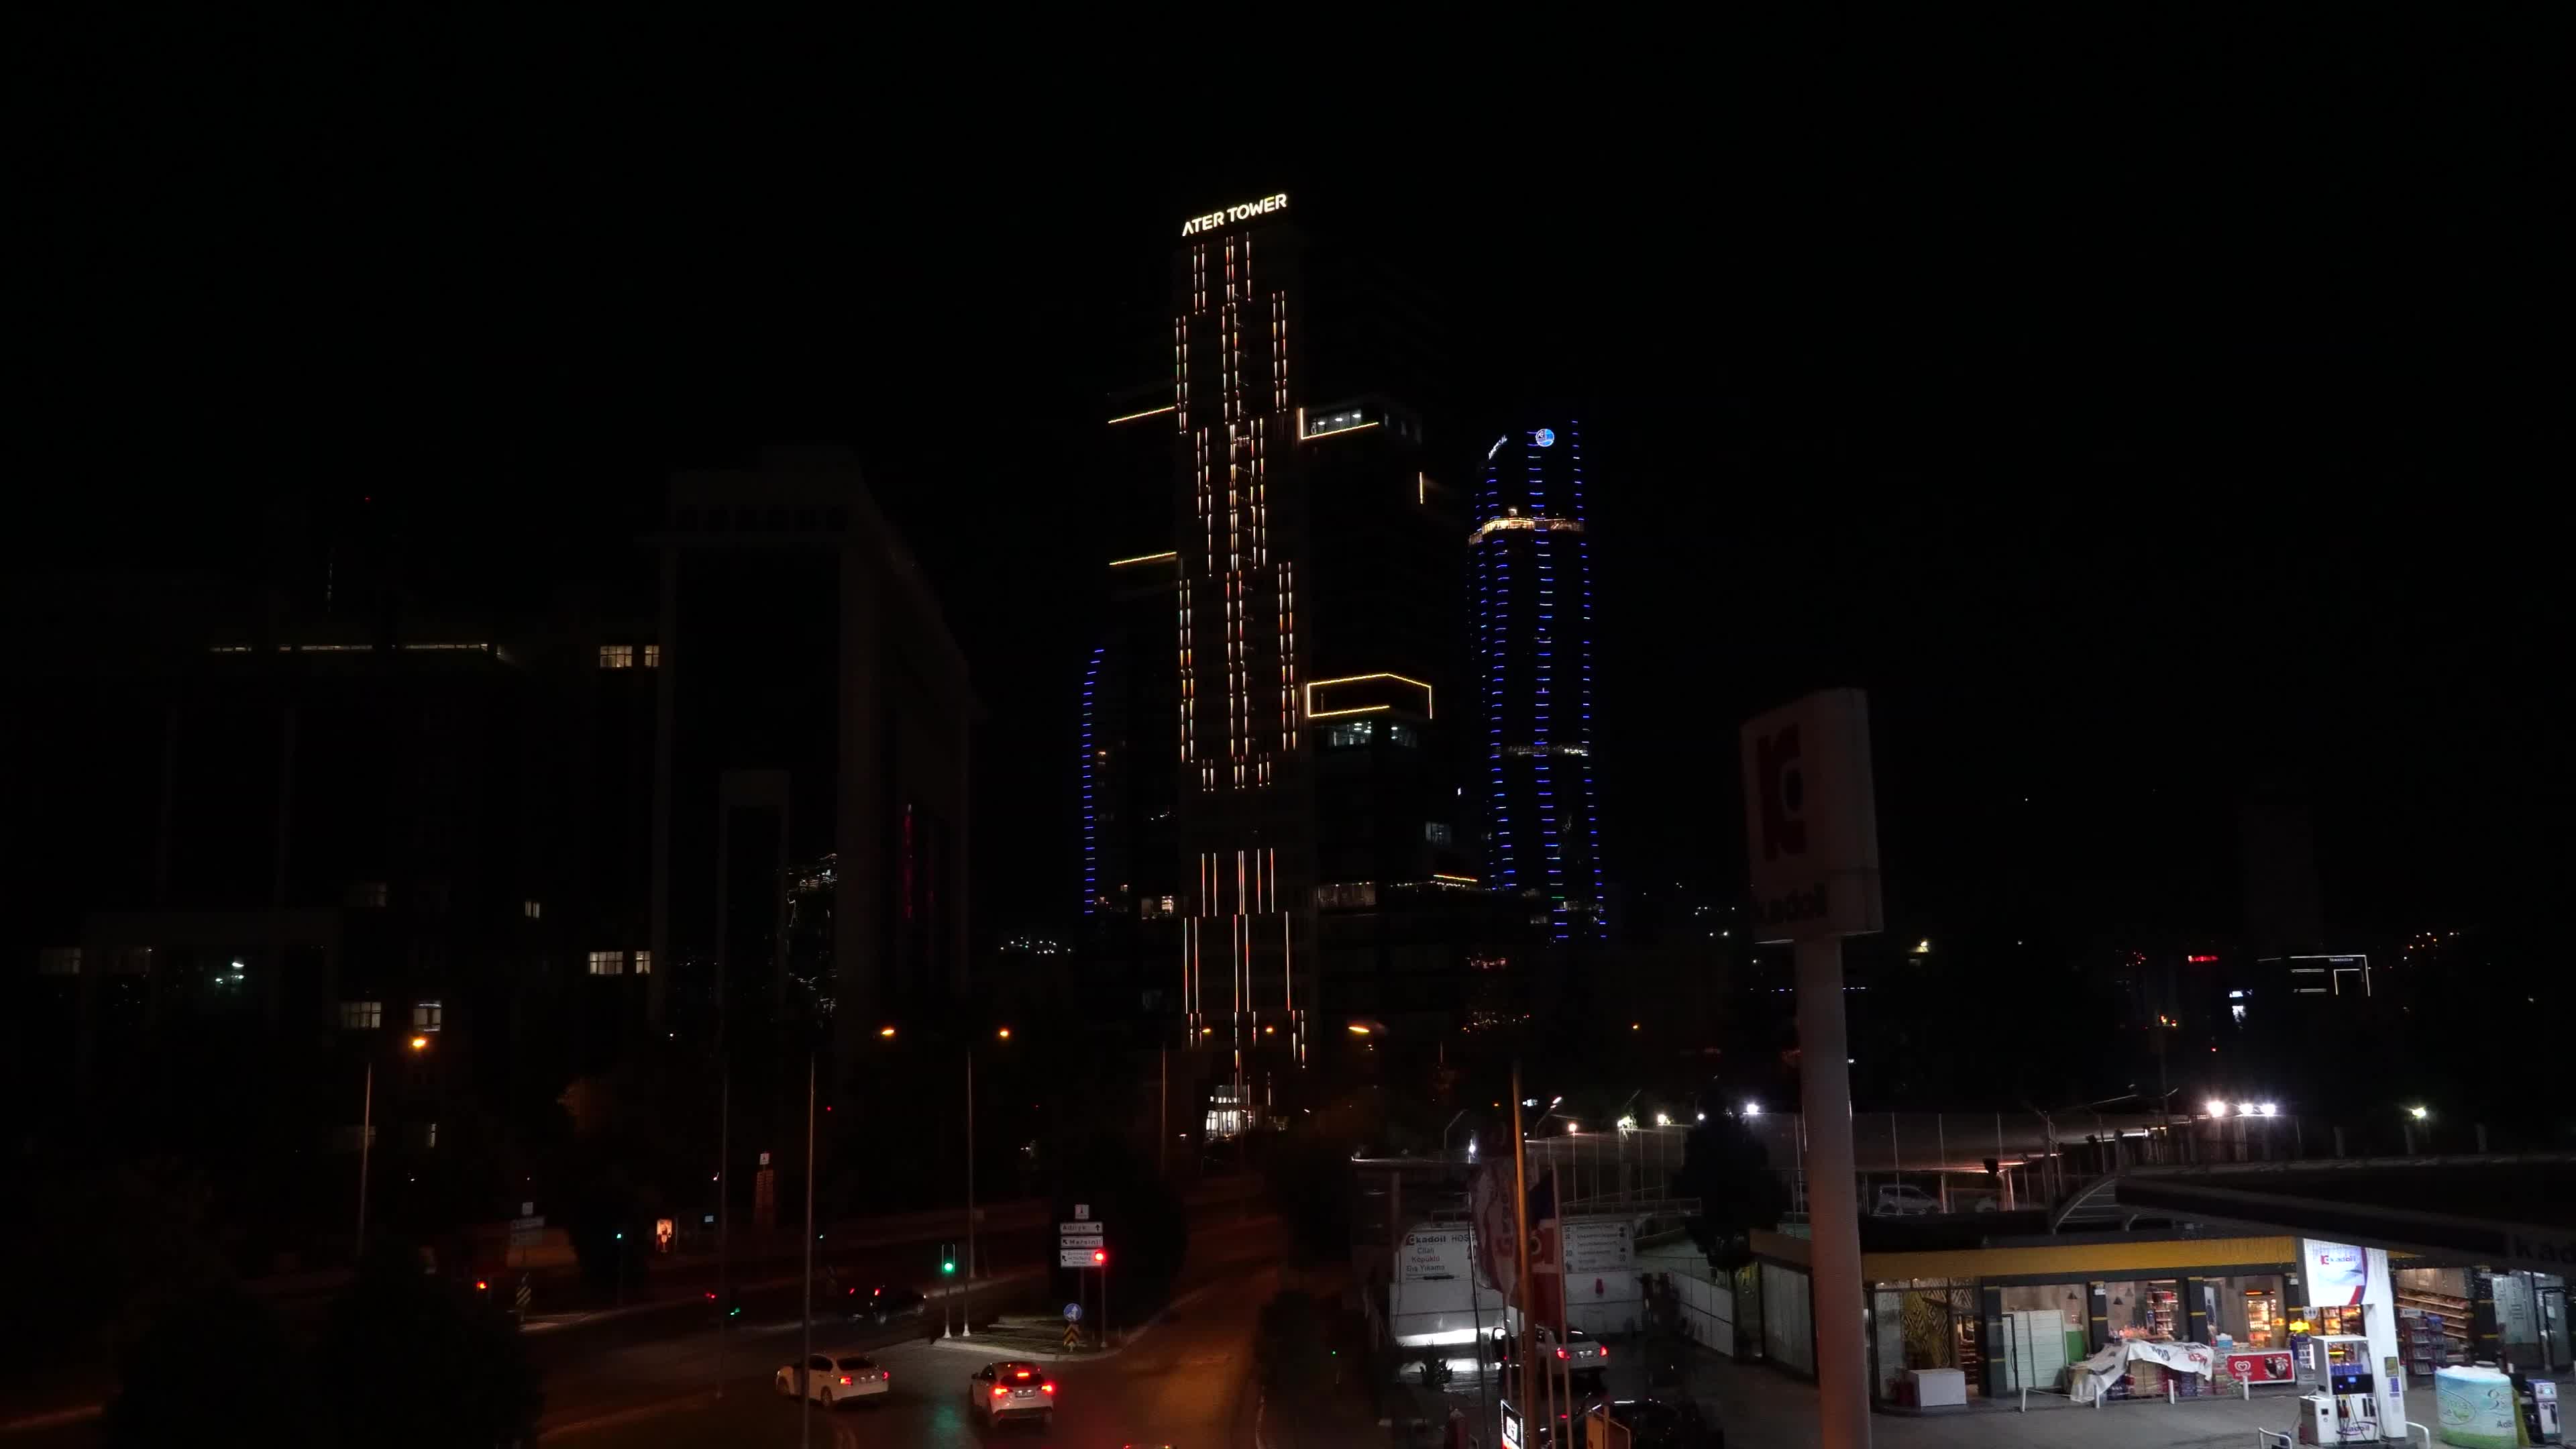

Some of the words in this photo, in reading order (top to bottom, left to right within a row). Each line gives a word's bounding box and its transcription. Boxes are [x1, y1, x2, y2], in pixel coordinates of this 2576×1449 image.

[1182, 211, 1224, 237] ATER
[1227, 193, 1287, 223] TOWER
[1416, 1234, 1446, 1243] kadoil
